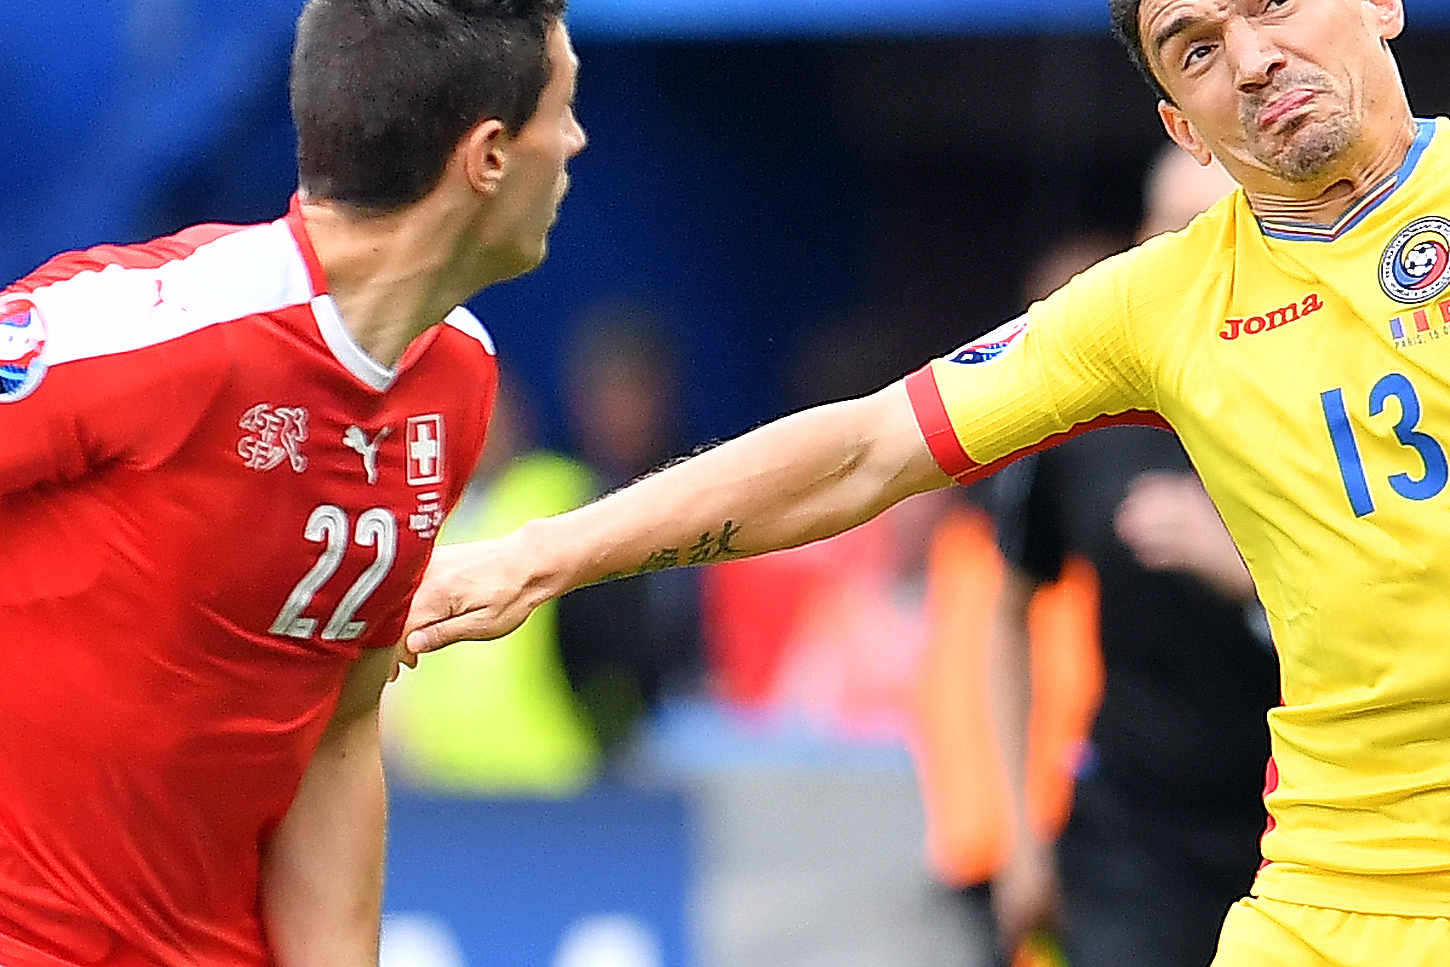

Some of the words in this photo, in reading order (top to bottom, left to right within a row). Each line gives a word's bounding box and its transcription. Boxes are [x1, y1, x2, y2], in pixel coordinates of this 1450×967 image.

[1219, 293, 1324, 340] Joma
[1319, 372, 1449, 519] 13
[267, 504, 399, 640] 22
